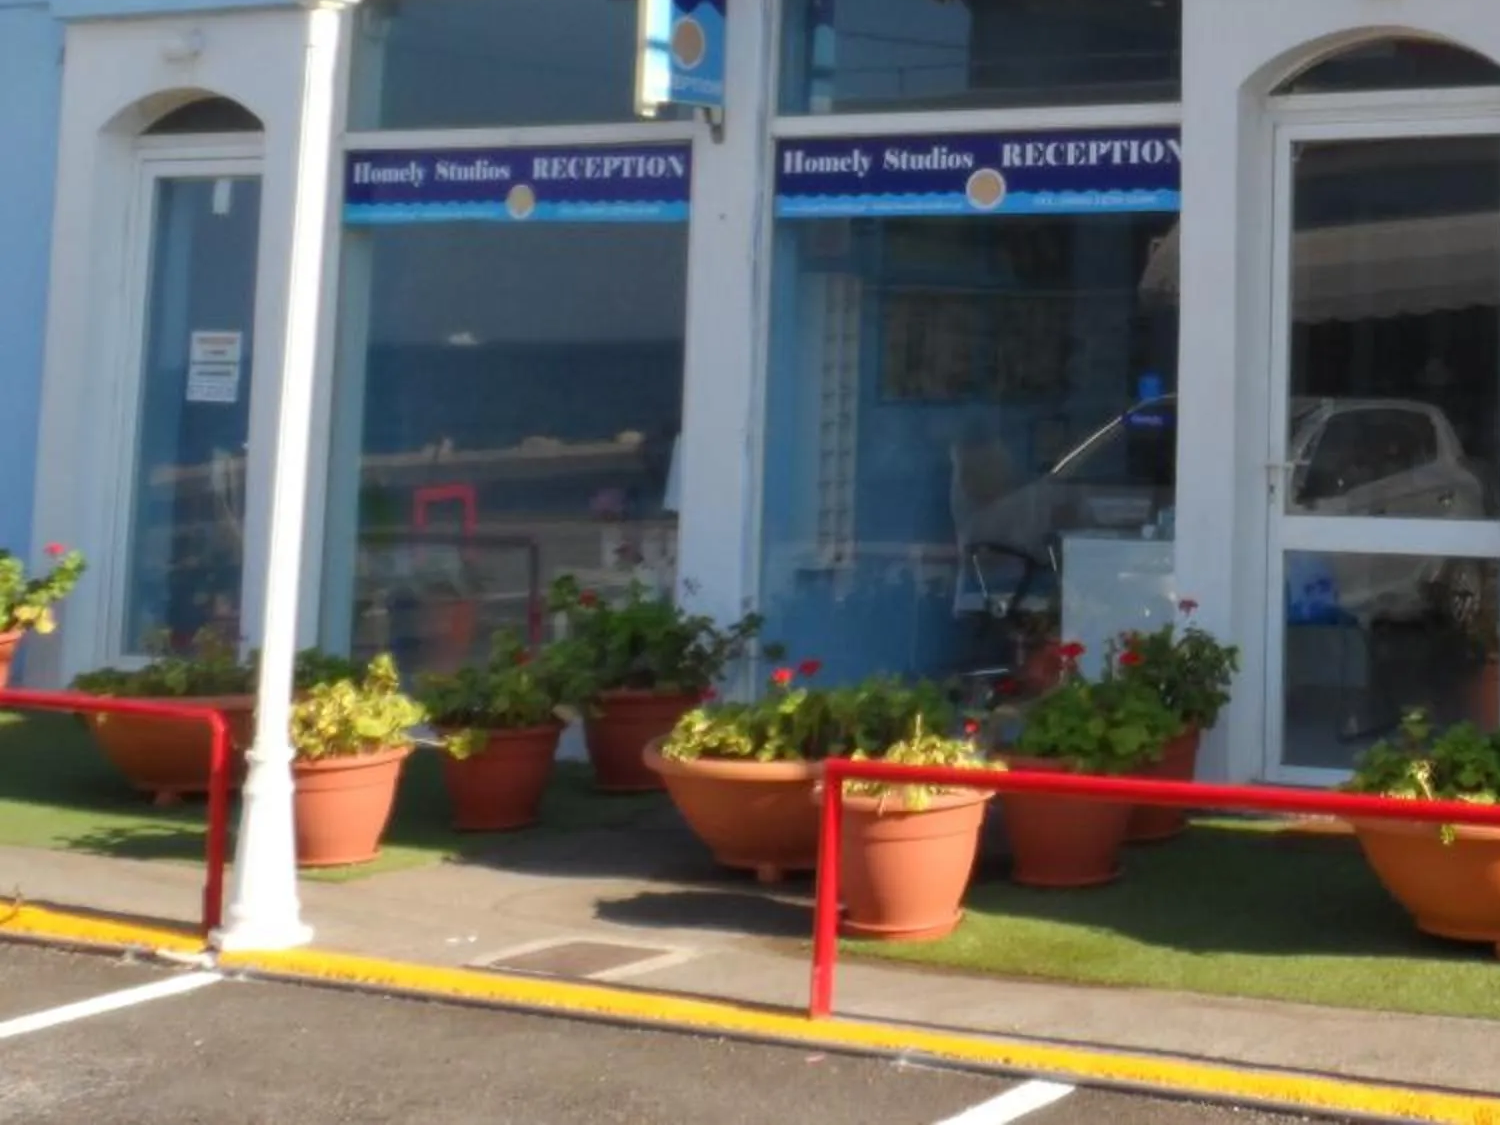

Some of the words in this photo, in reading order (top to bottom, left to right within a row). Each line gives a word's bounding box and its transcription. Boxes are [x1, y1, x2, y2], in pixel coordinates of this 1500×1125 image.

[353, 162, 425, 188] Homely
[433, 159, 511, 181] Studios
[532, 155, 685, 180] RECEPTION
[783, 148, 873, 178] Homely
[883, 145, 975, 171] Studios
